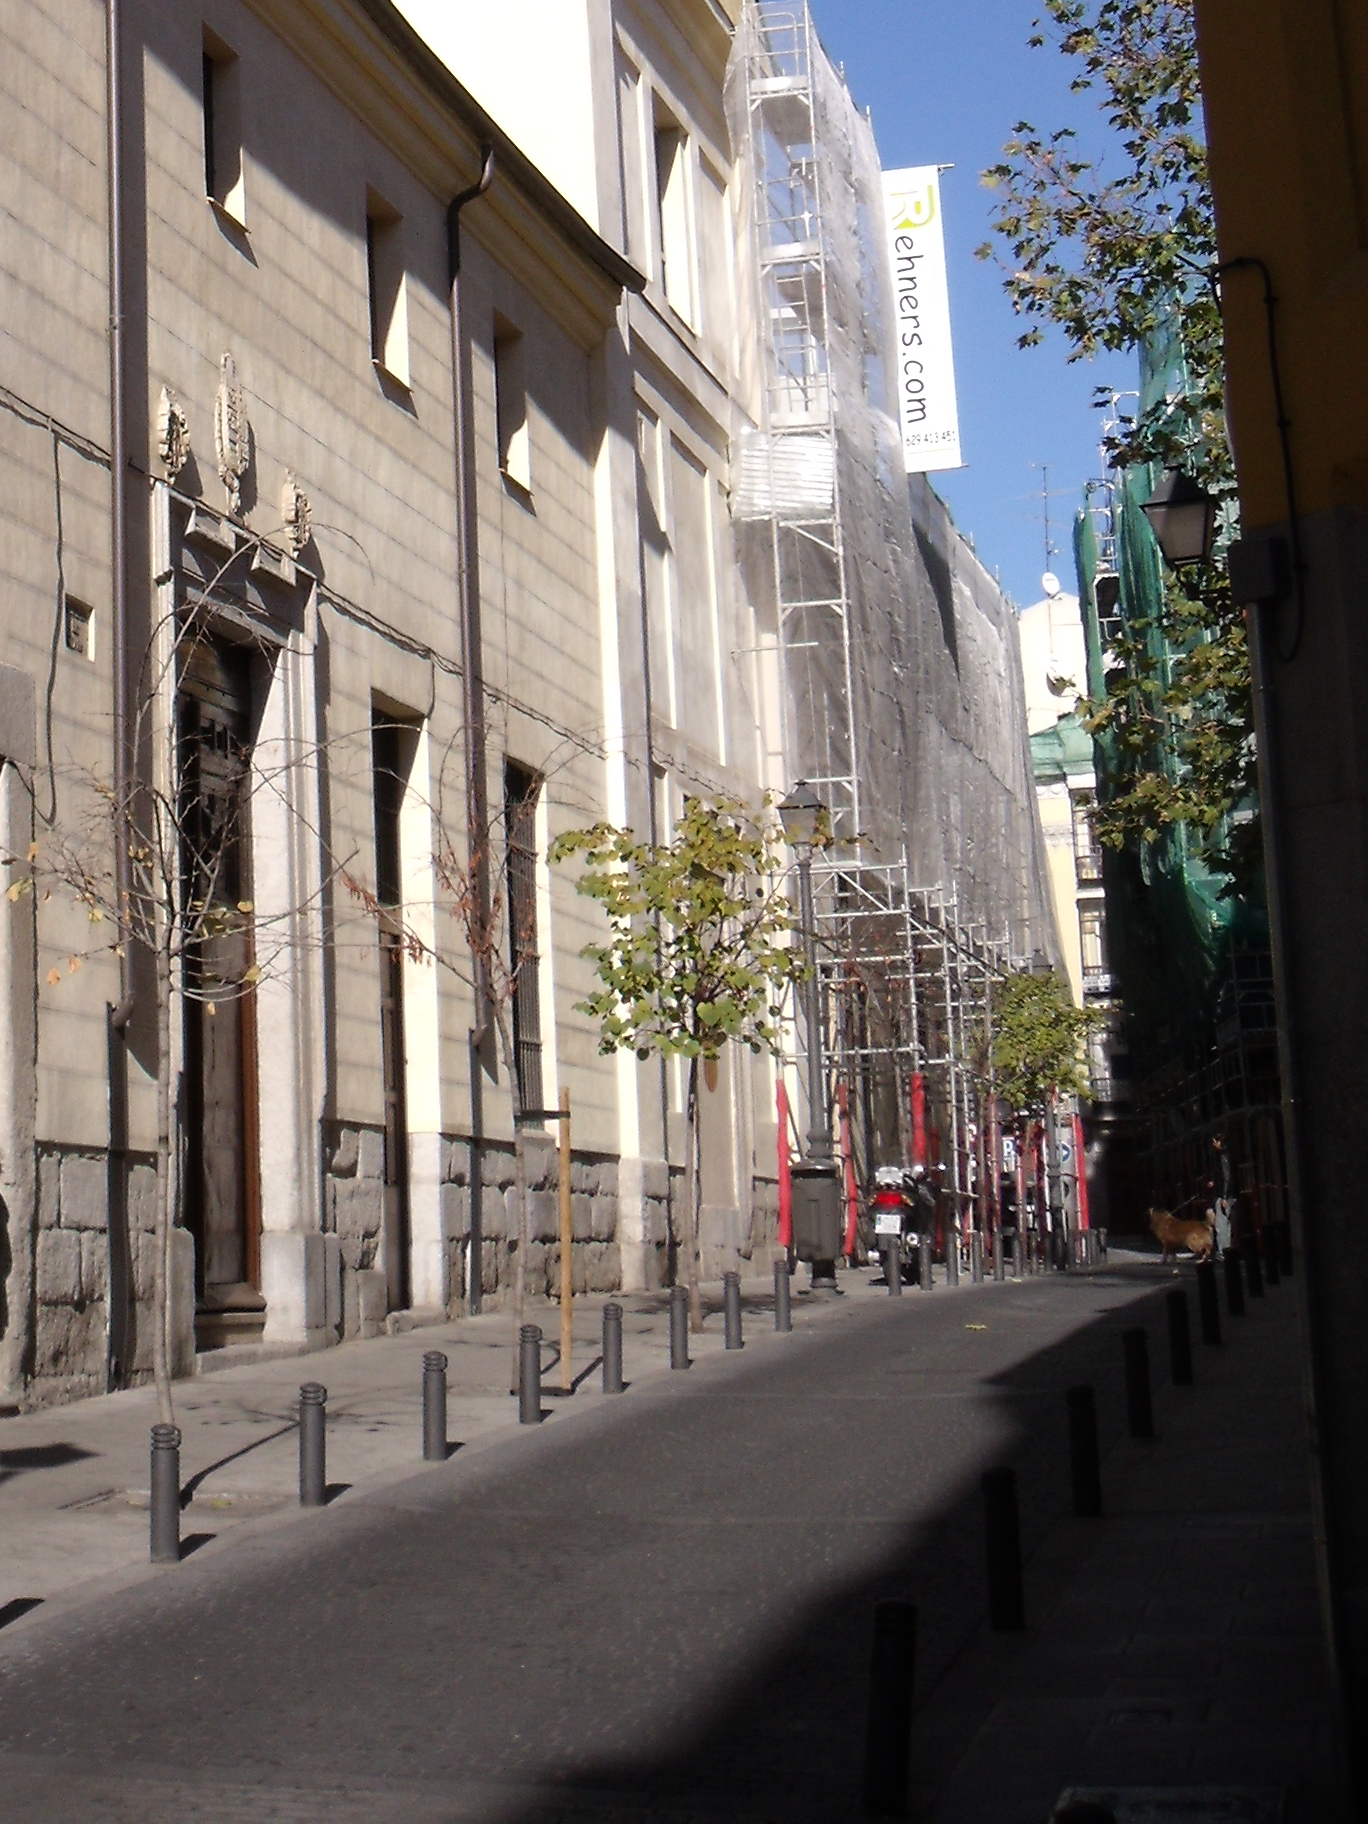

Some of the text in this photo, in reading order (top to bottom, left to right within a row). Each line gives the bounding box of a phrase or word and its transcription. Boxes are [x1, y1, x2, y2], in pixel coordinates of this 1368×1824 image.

[890, 184, 935, 424] Rehners.com
[906, 434, 921, 447] 629
[923, 432, 939, 444] 413
